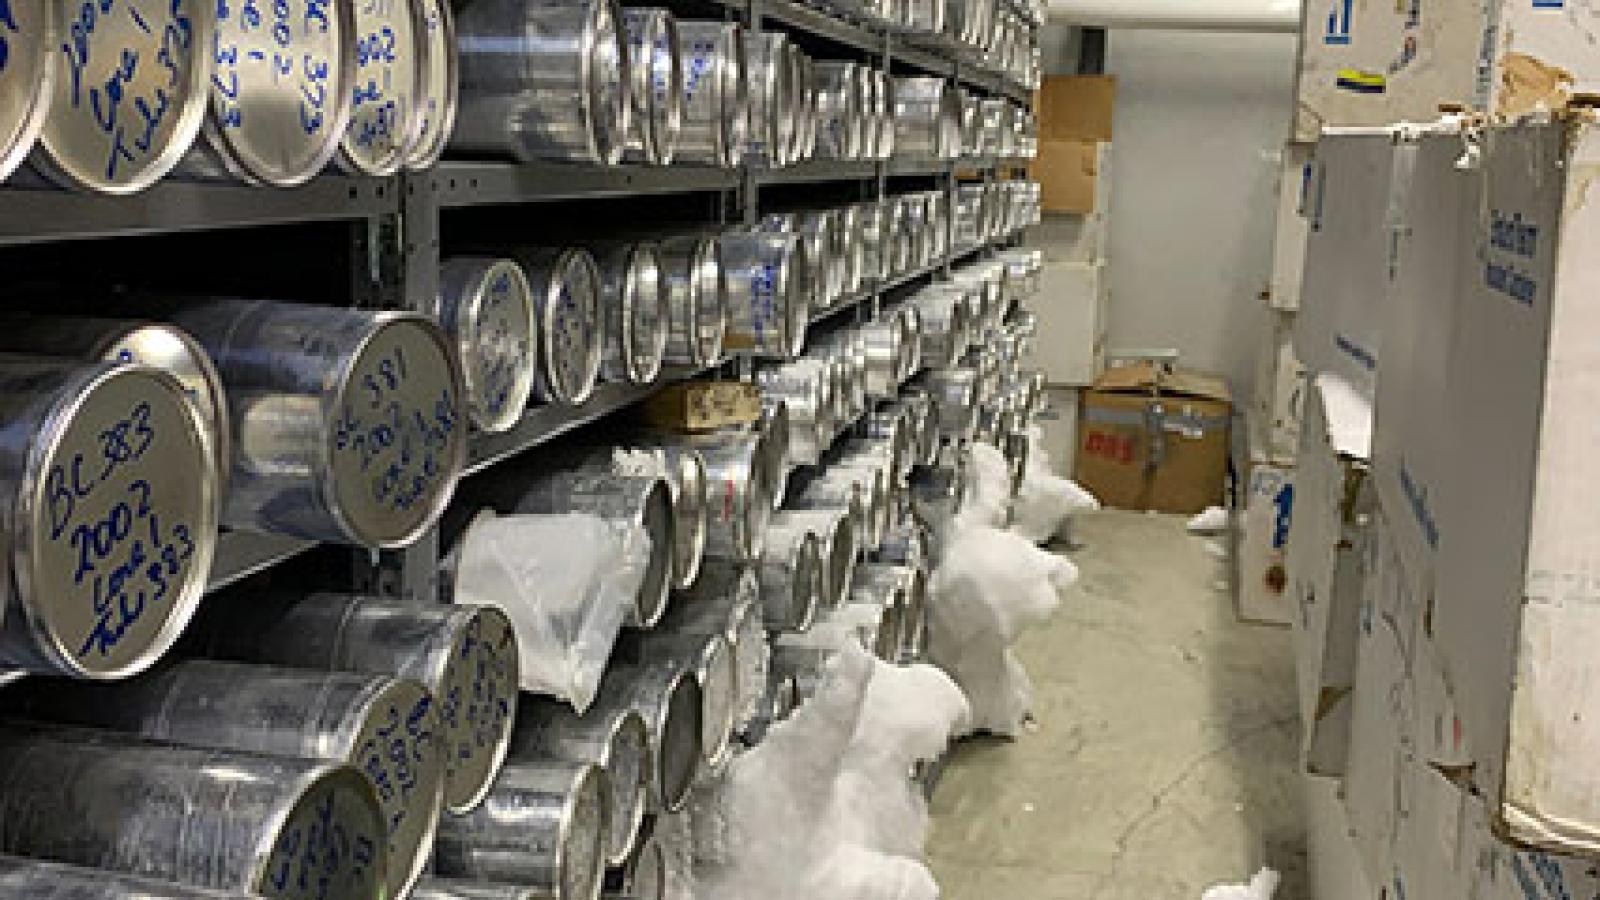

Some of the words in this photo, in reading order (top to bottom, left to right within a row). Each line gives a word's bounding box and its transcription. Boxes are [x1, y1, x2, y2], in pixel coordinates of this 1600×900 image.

[273, 0, 290, 86] 002
[300, 54, 328, 135] 373
[47, 453, 94, 541] BC
[97, 401, 155, 482] 383
[71, 480, 151, 585] 2002
[93, 541, 147, 615] Core
[149, 514, 162, 549] 1
[146, 524, 196, 601] 383
